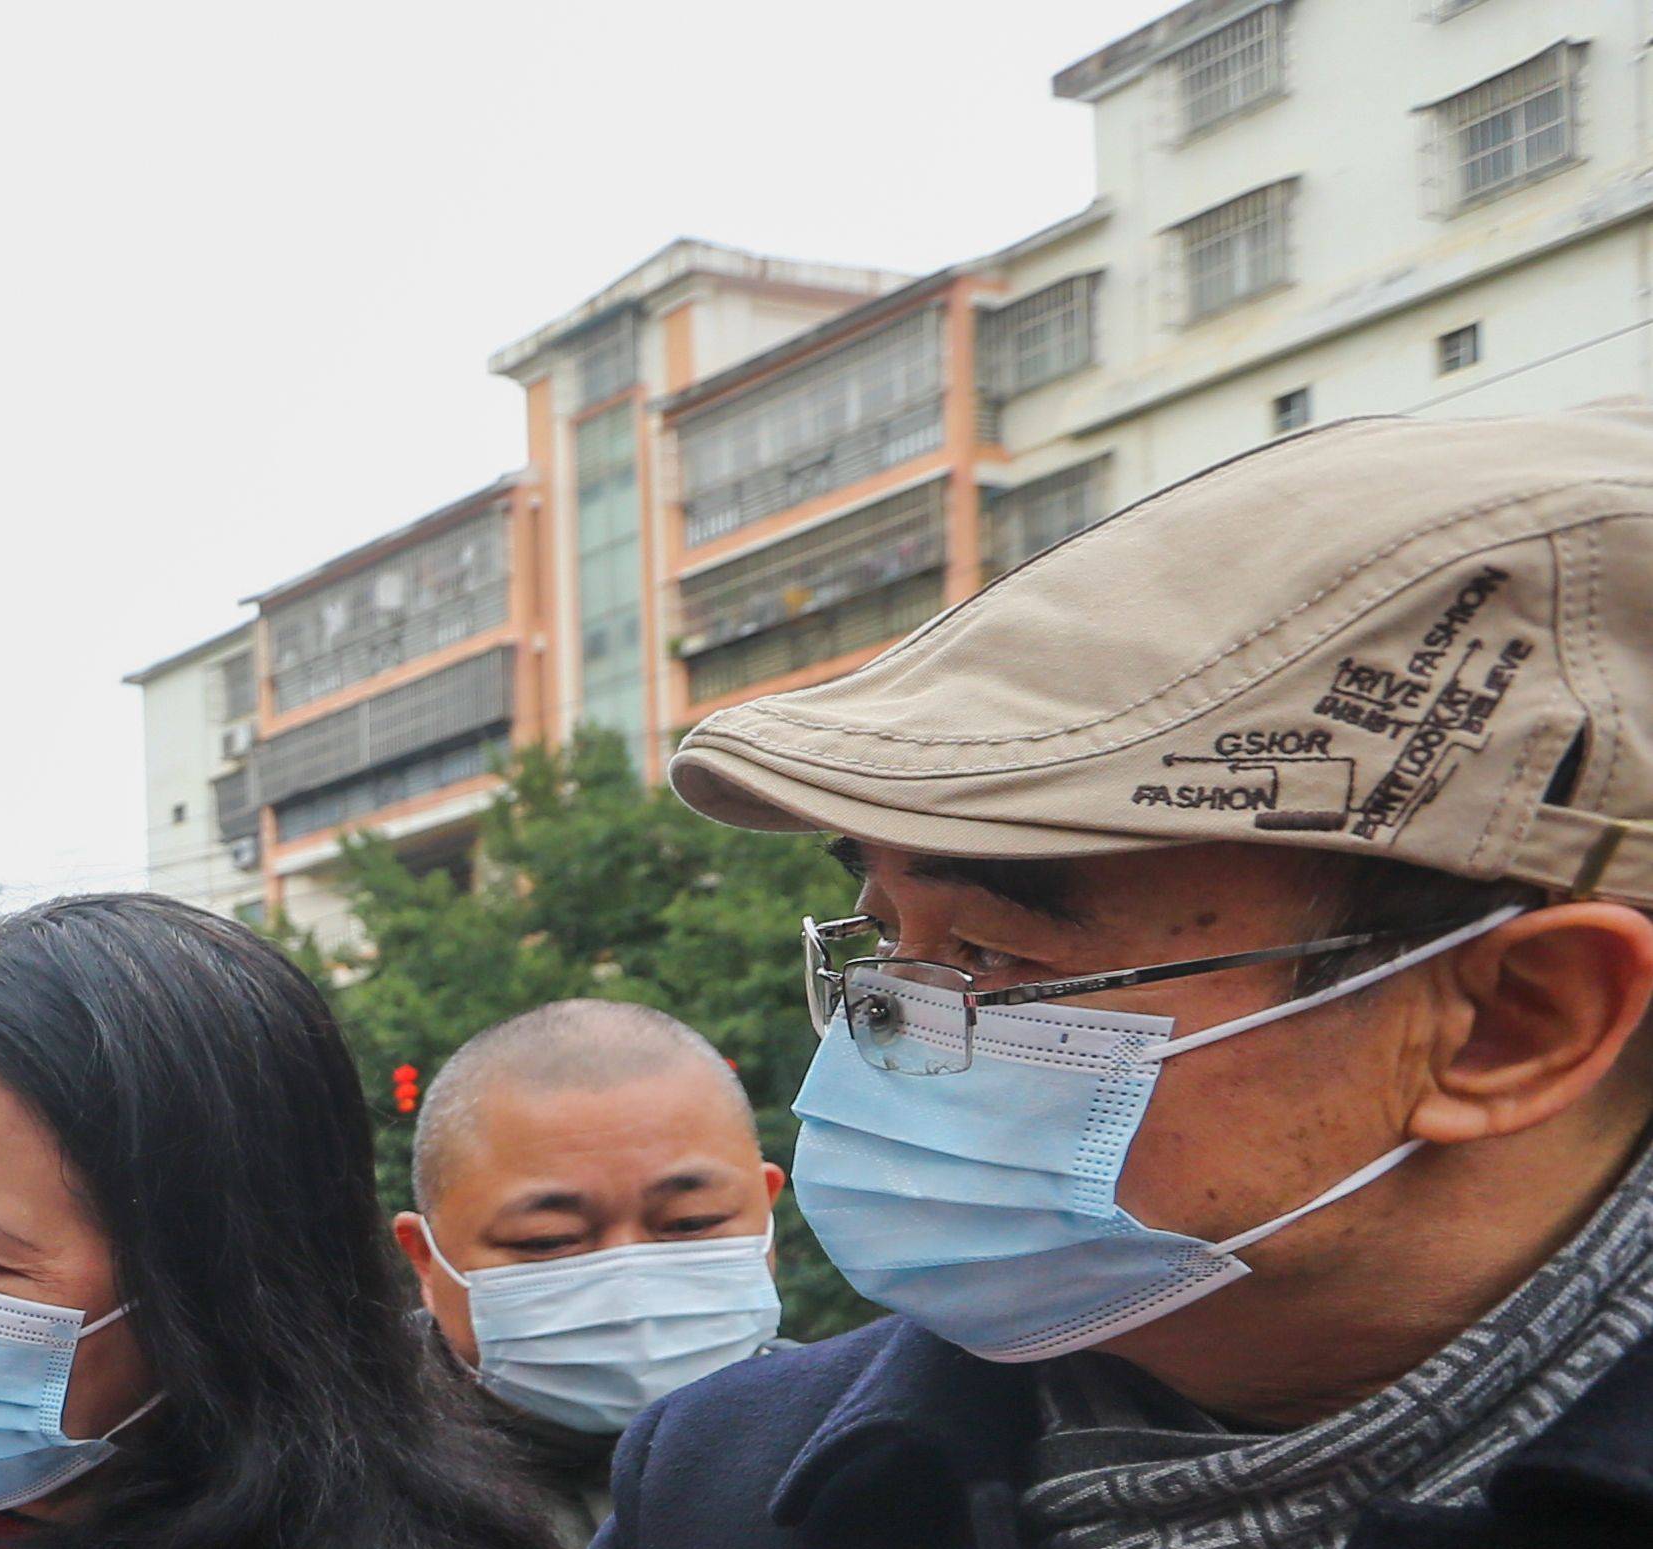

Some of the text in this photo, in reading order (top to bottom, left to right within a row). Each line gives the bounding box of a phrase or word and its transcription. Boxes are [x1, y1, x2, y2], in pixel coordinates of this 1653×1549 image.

[1408, 565, 1511, 679] FASHION
[1214, 729, 1332, 758] GSIOR
[1131, 785, 1278, 811] FASHION
